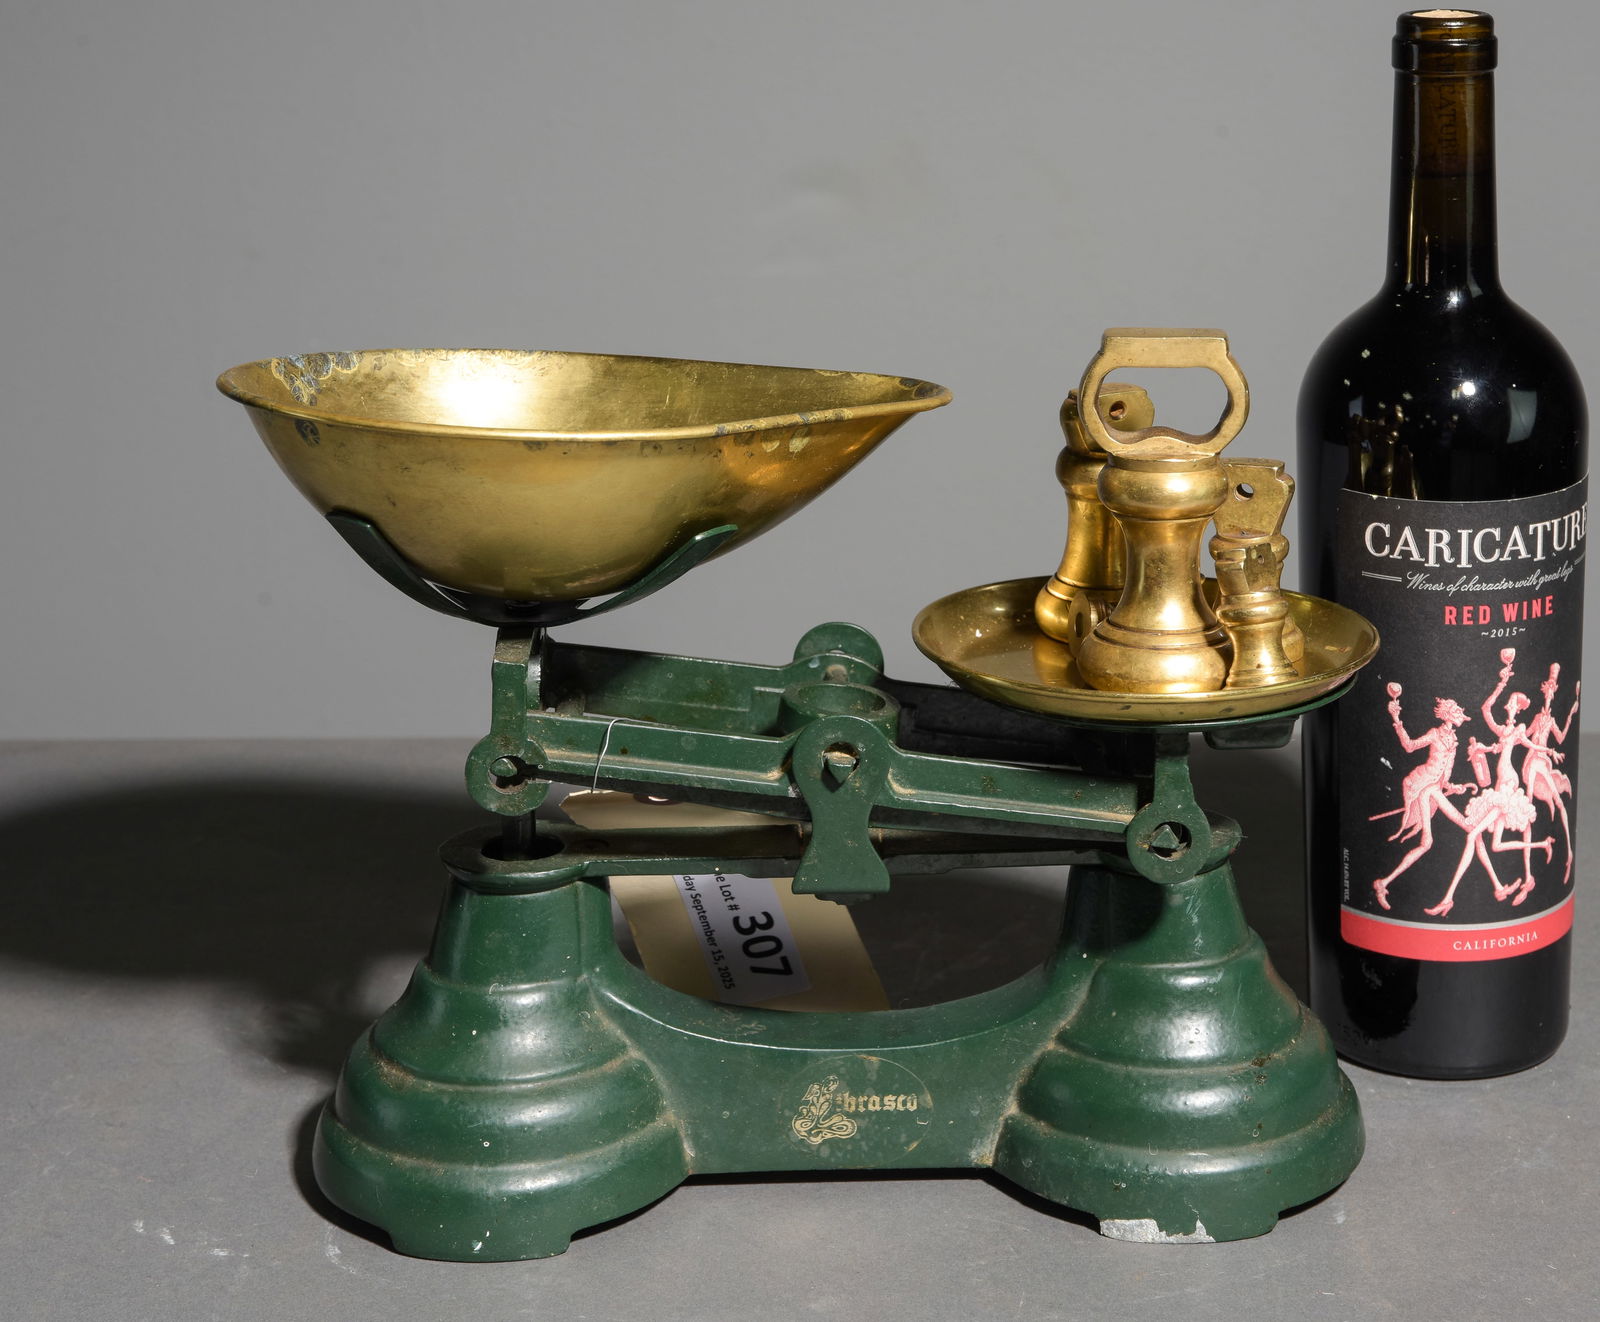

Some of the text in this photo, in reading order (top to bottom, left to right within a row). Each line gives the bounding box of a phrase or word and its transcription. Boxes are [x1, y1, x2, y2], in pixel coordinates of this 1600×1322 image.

[1364, 502, 1588, 568] CARICATURE
[1406, 571, 1445, 591] Wines
[1446, 575, 1461, 597] of
[1461, 575, 1515, 592] character
[1515, 568, 1538, 589] with
[1536, 567, 1562, 591] great
[1444, 595, 1554, 626] RED WINE
[719, 884, 736, 902] Lot
[727, 904, 741, 912] #
[690, 892, 718, 947] September
[711, 949, 725, 965] 15,
[718, 966, 737, 990] 2025
[733, 911, 793, 976] 307
[1453, 931, 1539, 951] CALIFORNIA
